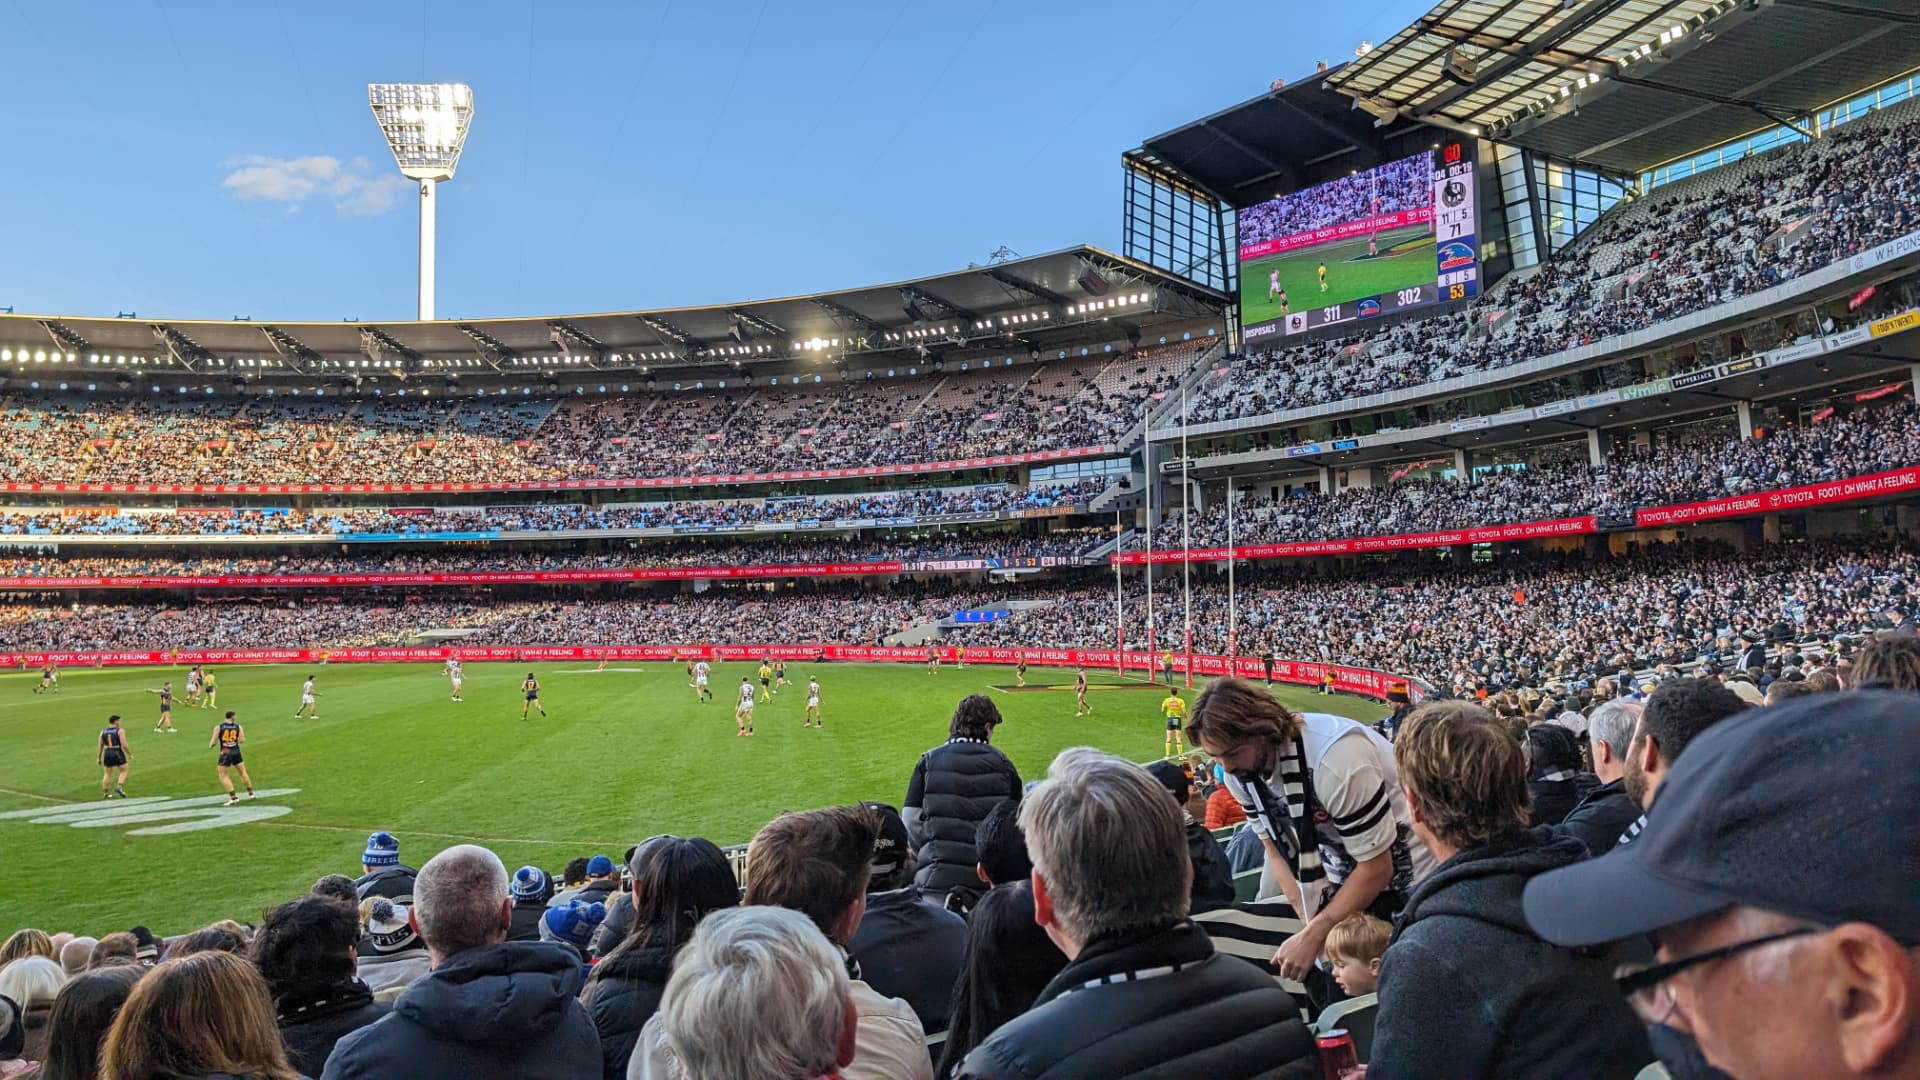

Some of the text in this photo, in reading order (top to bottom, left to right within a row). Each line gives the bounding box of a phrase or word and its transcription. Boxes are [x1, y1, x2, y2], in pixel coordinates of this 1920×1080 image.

[420, 185, 429, 197] 4
[1442, 209, 1467, 224] 11 5
[1449, 223, 1462, 237] 71
[1290, 234, 1313, 244] TOYOTA
[1875, 250, 1884, 261] W
[1887, 248, 1893, 256] H
[1464, 270, 1469, 280] 5
[1397, 287, 1421, 306] 302
[1450, 284, 1464, 300] 53
[1324, 305, 1341, 322] 311
[1783, 491, 1814, 503] TOYOTA
[1844, 485, 1856, 495] OH
[1855, 480, 1877, 492] WHAT
[1878, 478, 1884, 488] A
[1884, 472, 1917, 488] FEELING!
[1643, 512, 1670, 521] TOYOTA
[1697, 507, 1708, 515] OH
[1708, 504, 1726, 514] WHAT
[107, 734, 112, 747] 1
[222, 730, 237, 742] 48
